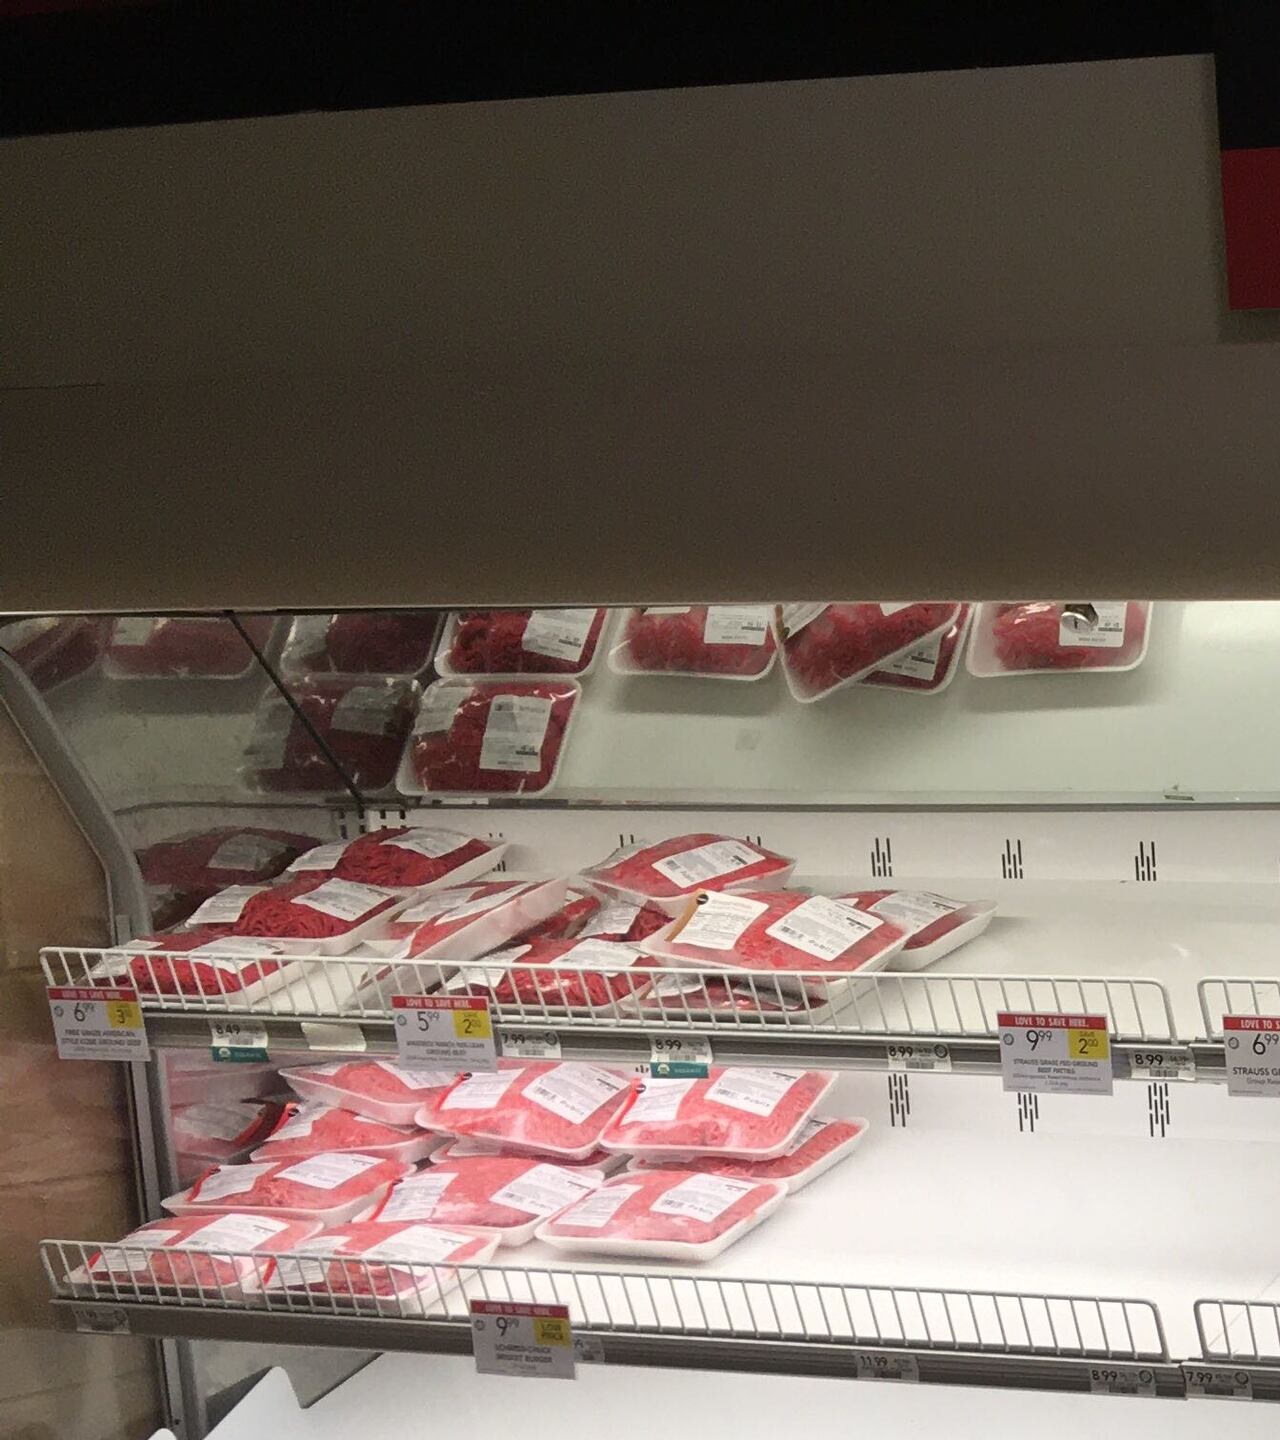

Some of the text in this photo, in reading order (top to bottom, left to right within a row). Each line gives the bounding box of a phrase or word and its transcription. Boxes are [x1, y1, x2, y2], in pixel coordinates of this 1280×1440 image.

[1240, 1019, 1259, 1028] LOVE
[1263, 1020, 1273, 1028] TO
[1233, 1066, 1270, 1076] STRAUSS
